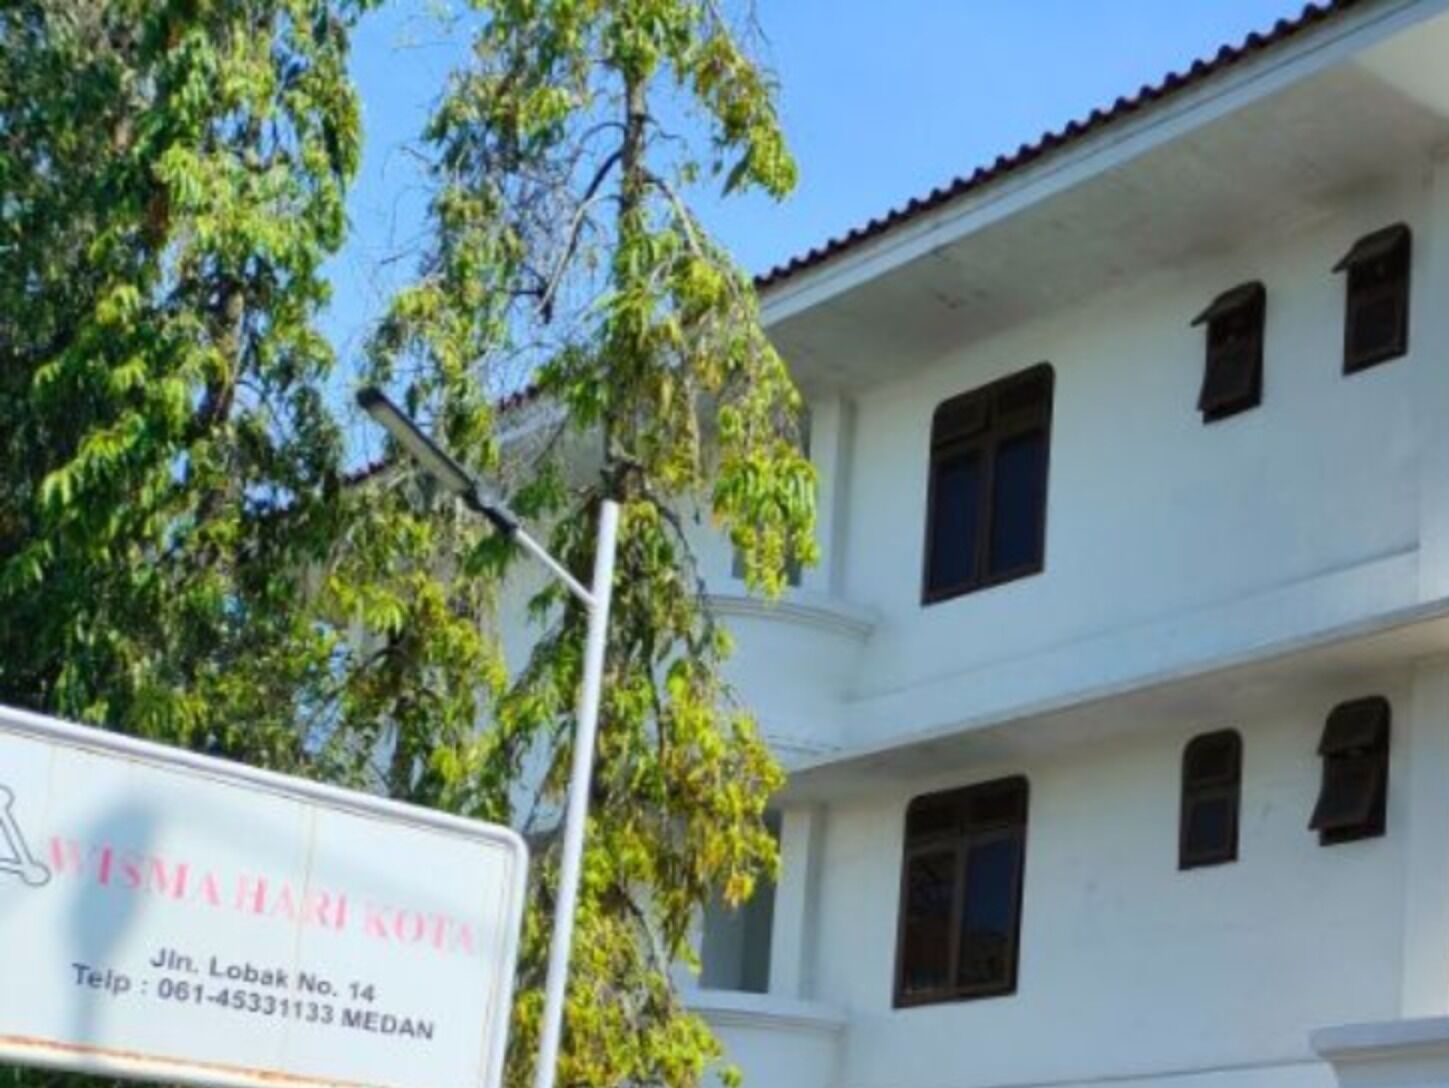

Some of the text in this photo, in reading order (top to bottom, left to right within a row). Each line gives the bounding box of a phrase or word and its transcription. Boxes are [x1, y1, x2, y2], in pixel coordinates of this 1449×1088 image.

[50, 836, 477, 955] WISMA HARI KOTA
[72, 962, 131, 995] Telp
[158, 977, 334, 1025] 061-45331133
[341, 1007, 434, 1041] MEDAN
[149, 948, 376, 1003] Jln. Lobak No. 14
